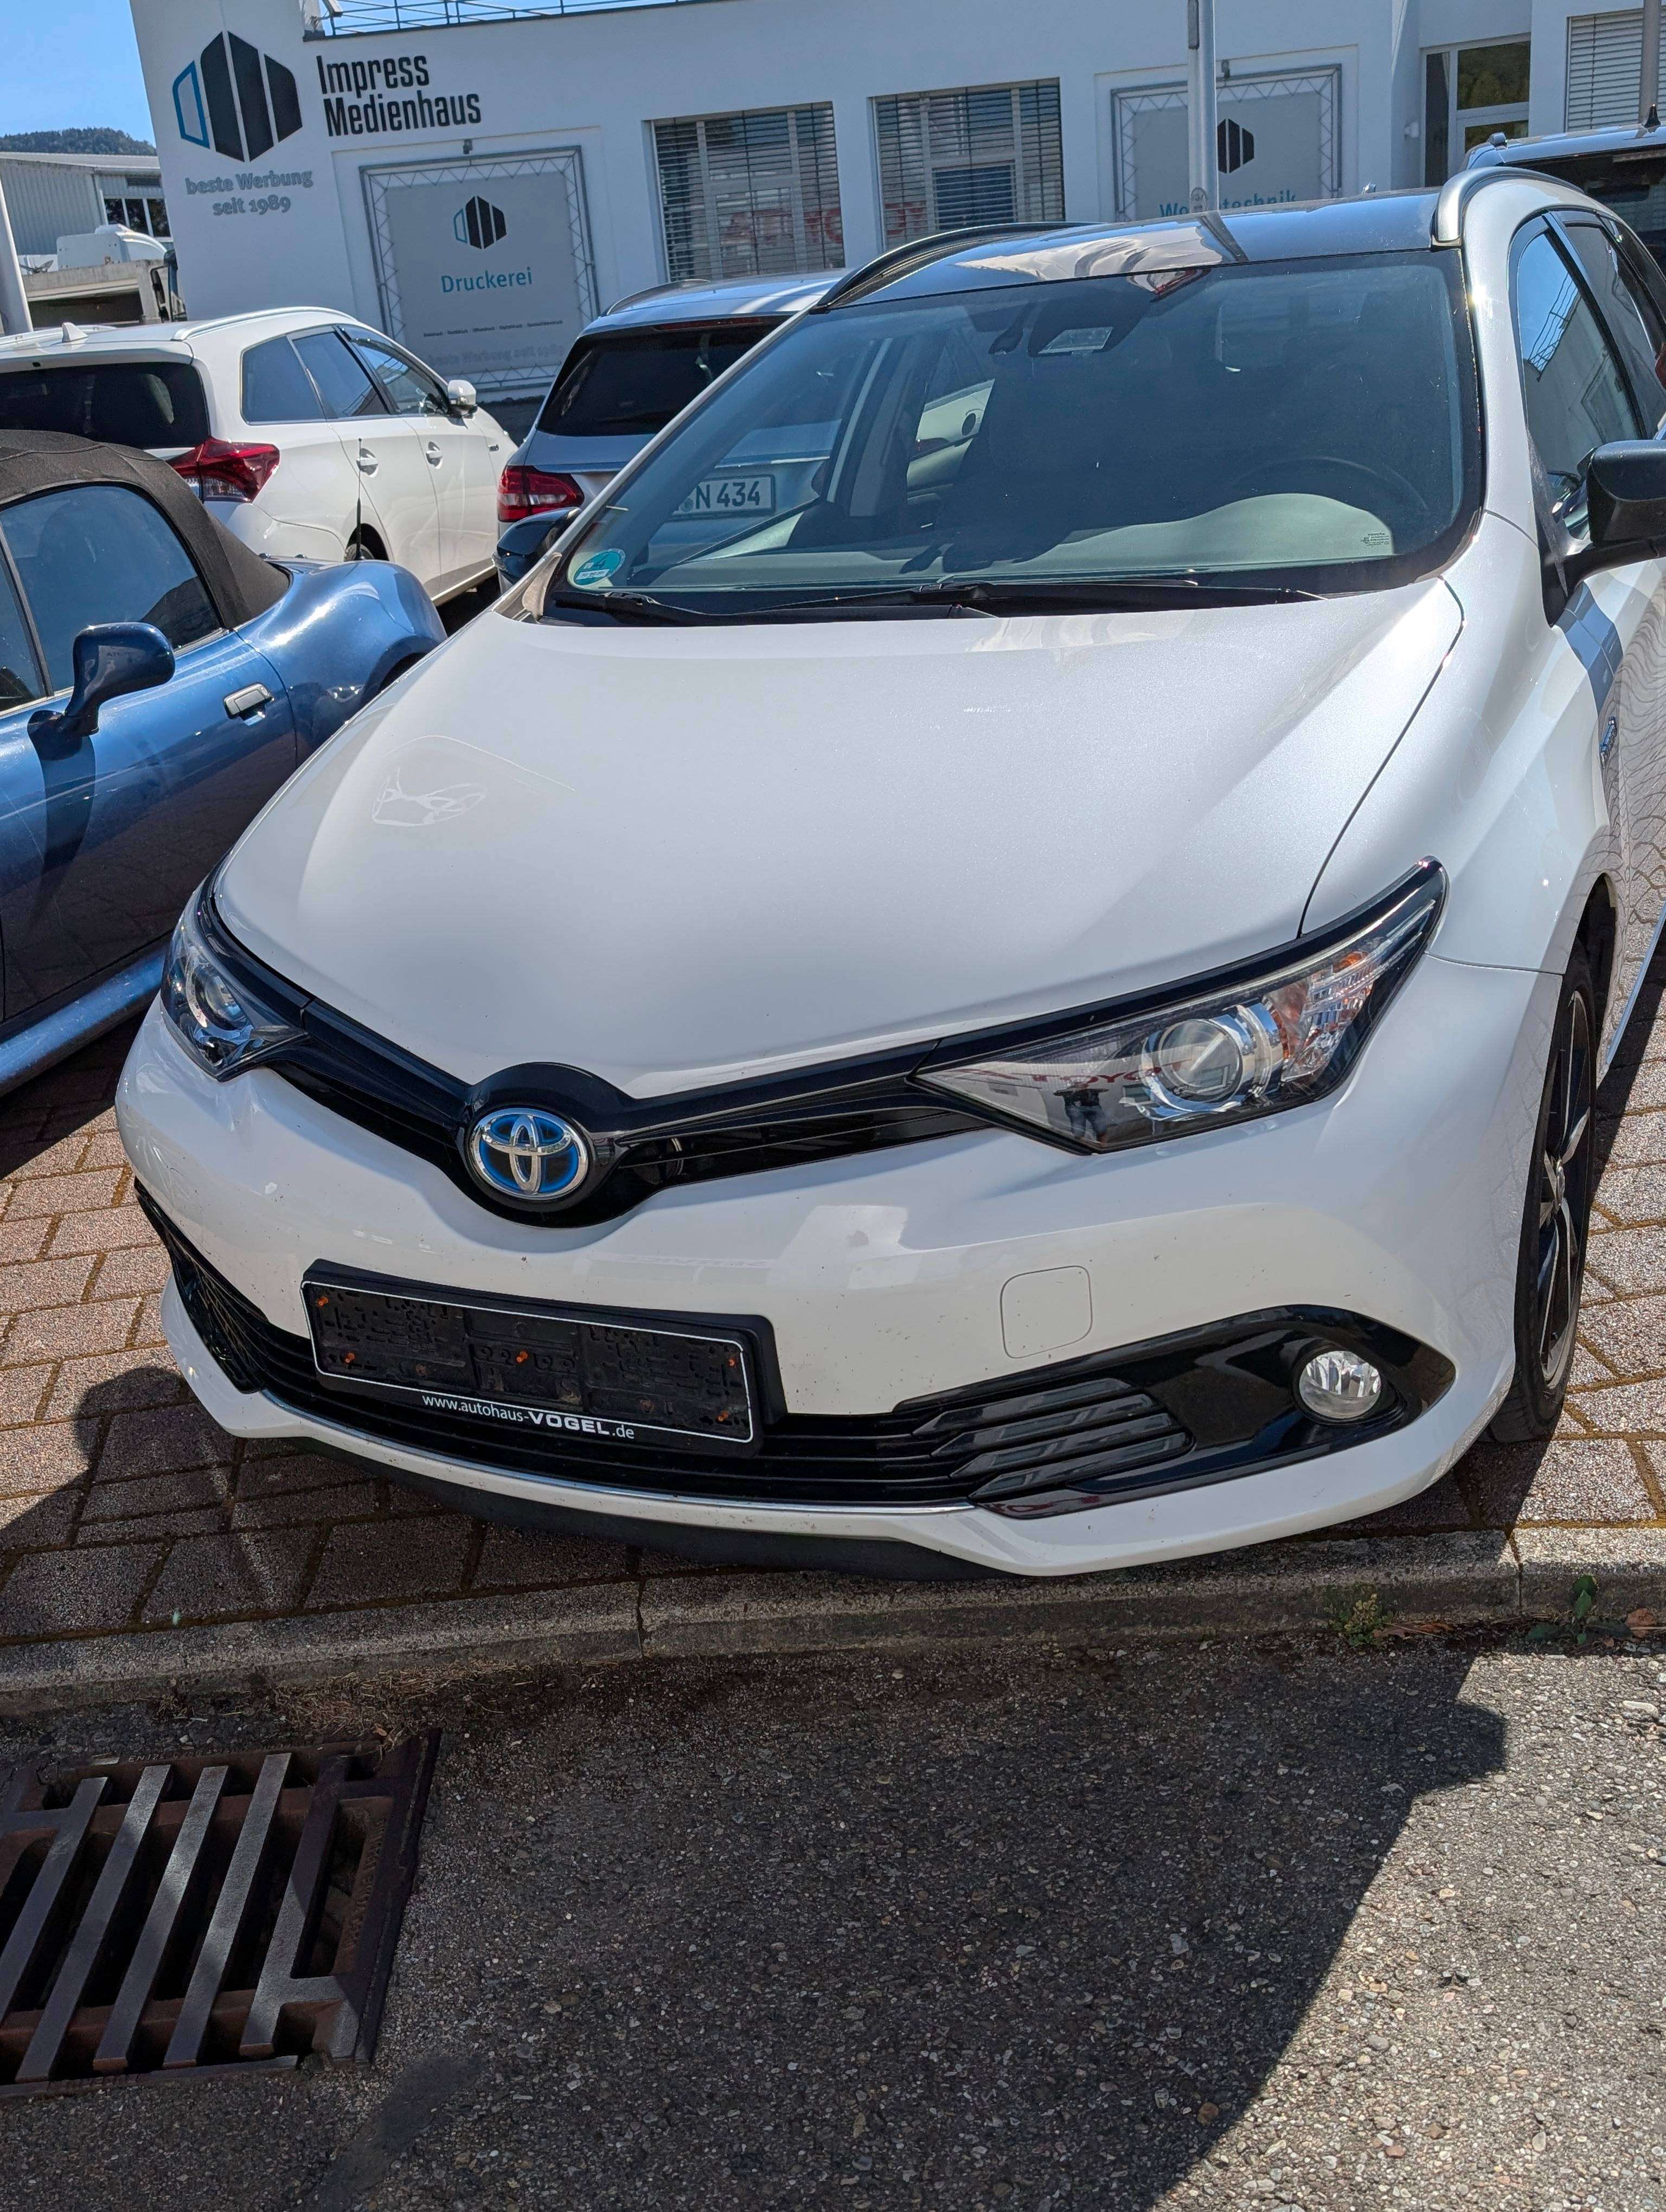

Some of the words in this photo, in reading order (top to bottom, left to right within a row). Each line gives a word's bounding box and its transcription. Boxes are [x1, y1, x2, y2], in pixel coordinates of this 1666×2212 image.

[316, 55, 430, 98] Impress
[323, 90, 481, 137] Medienhaus
[185, 177, 233, 195] beste
[235, 170, 313, 190] Werbung
[213, 197, 246, 216] seit
[248, 194, 291, 215] 1989
[441, 266, 533, 293] Druckerei
[716, 481, 760, 507] 434
[422, 1396, 635, 1439] www.autohaus-VOGEL.de
